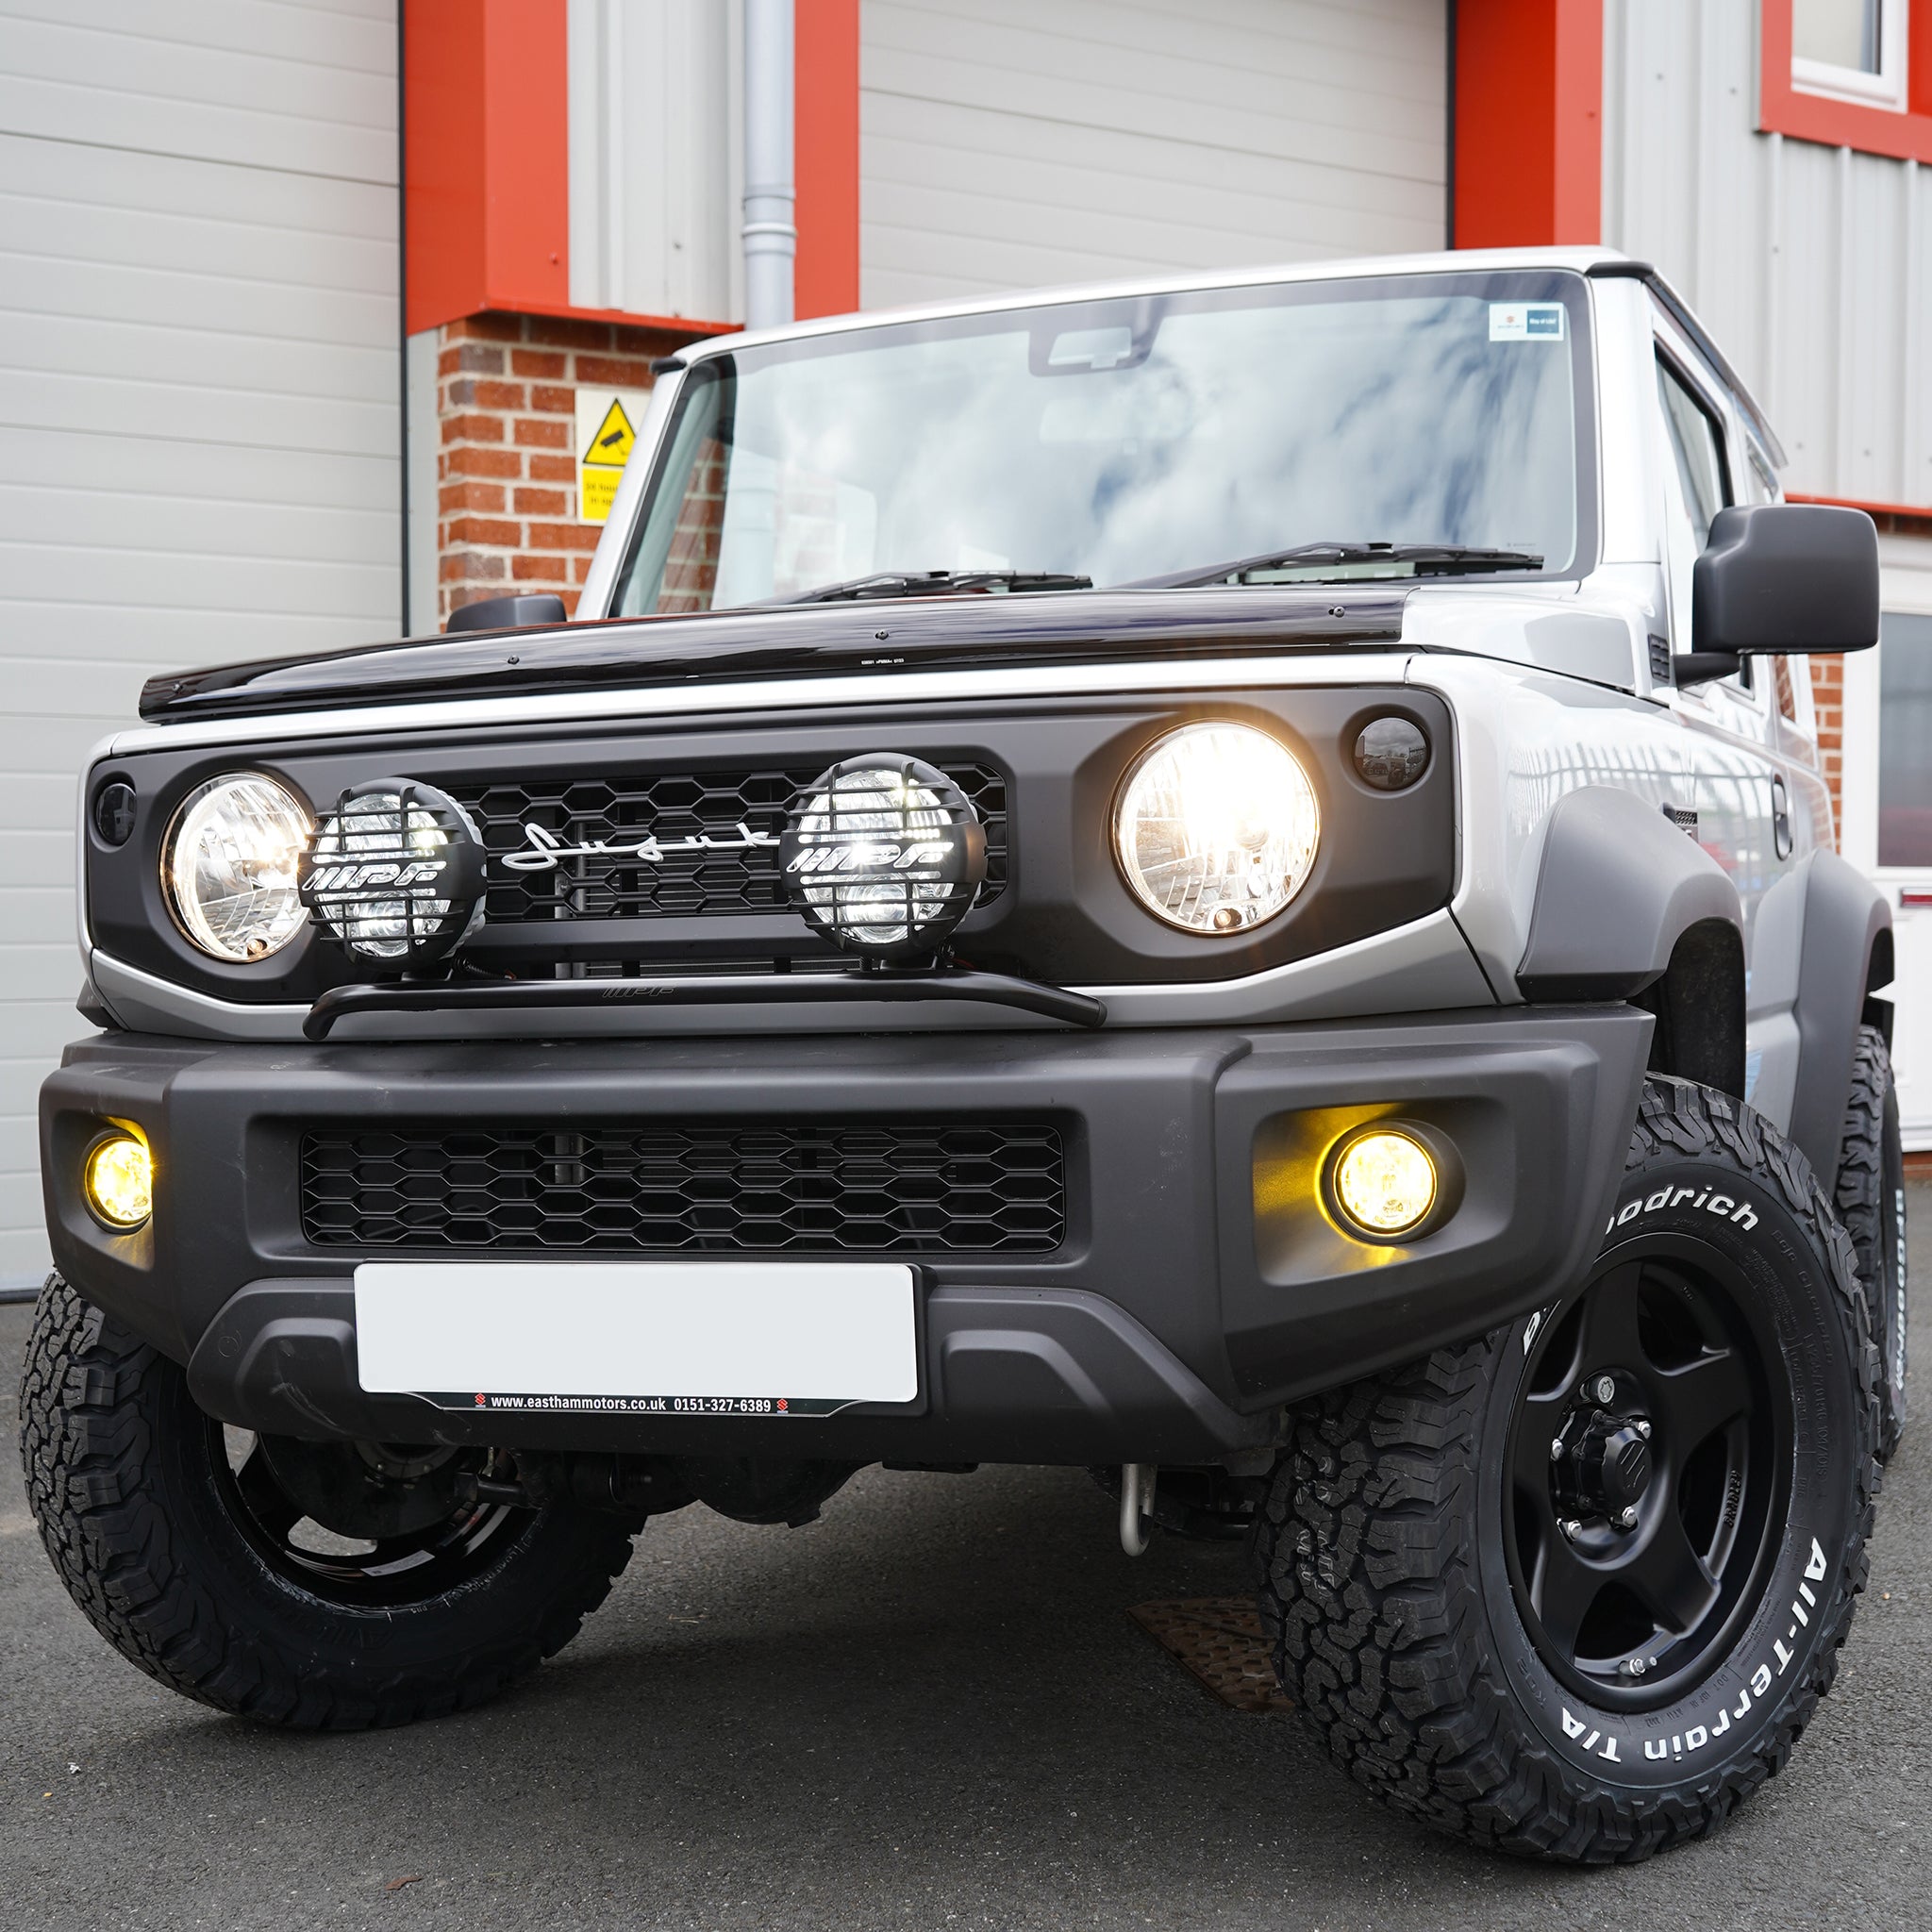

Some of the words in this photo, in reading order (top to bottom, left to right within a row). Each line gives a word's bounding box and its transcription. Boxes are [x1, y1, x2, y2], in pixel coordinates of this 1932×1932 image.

[501, 823, 781, 870] Suzuk
[491, 1396, 667, 1411] www.easthammotors.co.uk
[674, 1398, 772, 1413] 0151-327-6389
